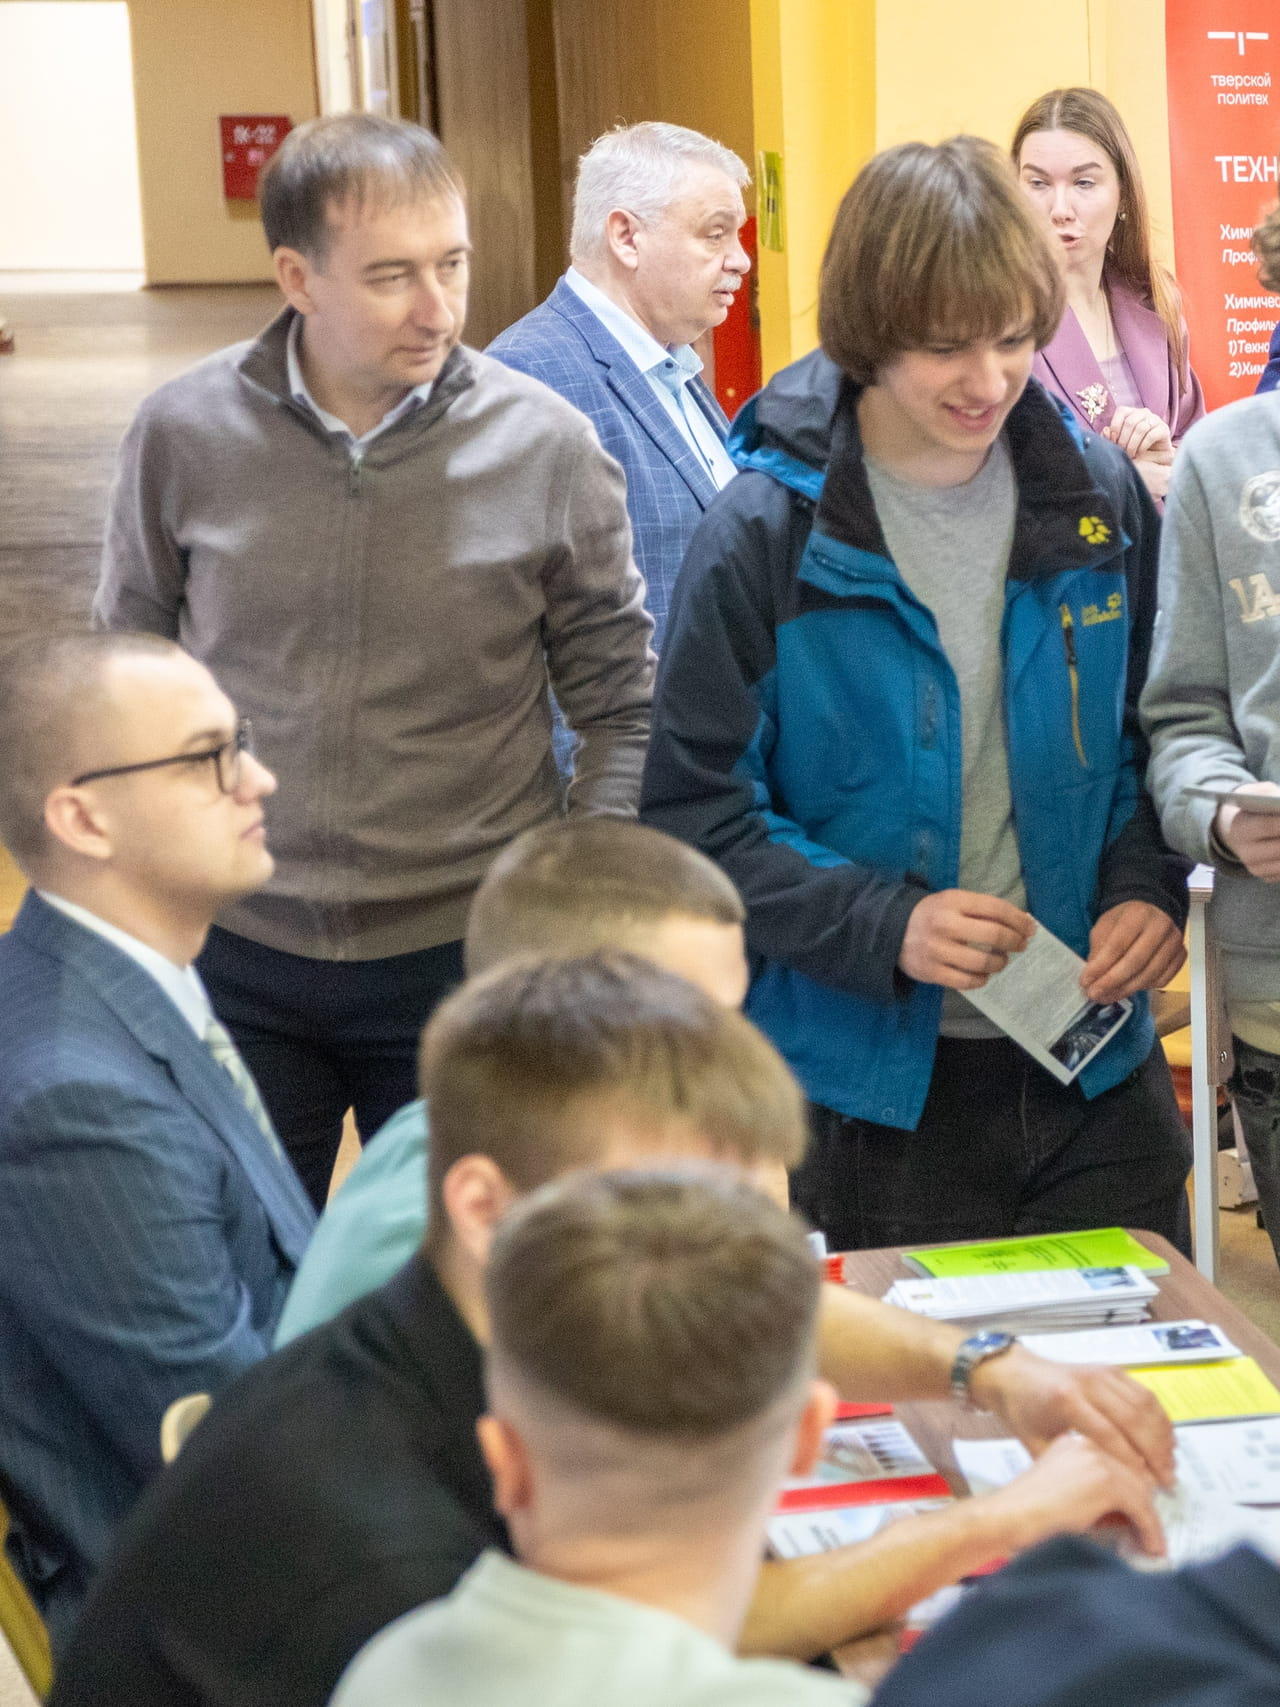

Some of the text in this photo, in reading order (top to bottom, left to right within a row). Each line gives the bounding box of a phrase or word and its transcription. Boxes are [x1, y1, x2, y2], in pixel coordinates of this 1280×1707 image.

[1210, 72, 1272, 90] тверской
[1217, 92, 1269, 105] политех
[1214, 155, 1280, 183] ТЕХН
[1222, 249, 1258, 266] Проф
[1226, 318, 1279, 335] Профиль
